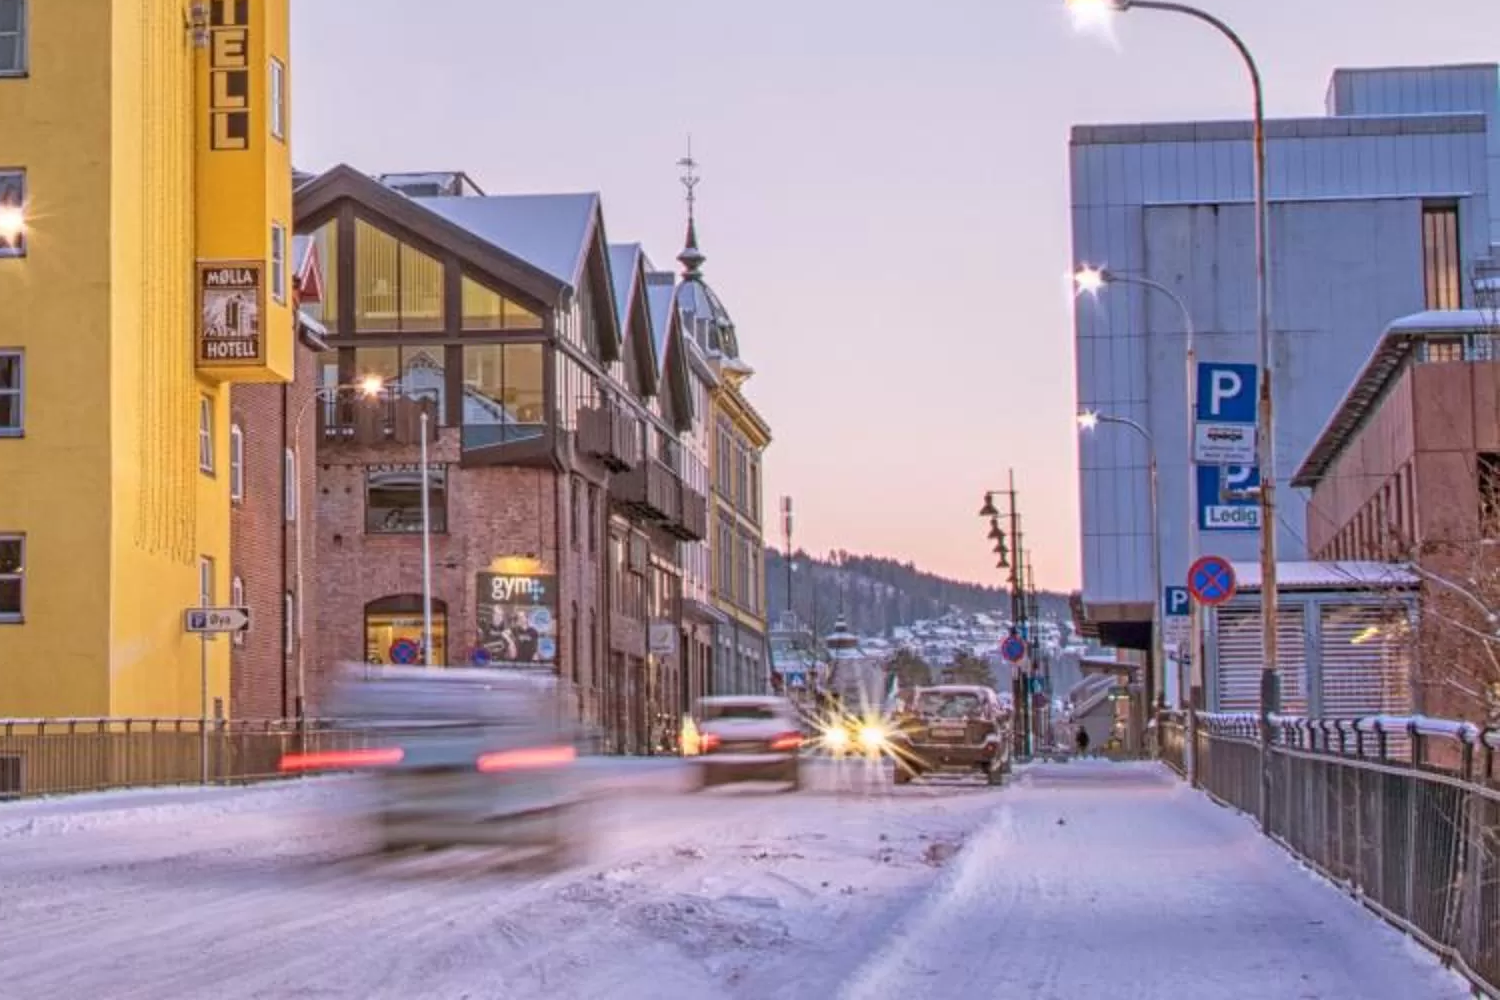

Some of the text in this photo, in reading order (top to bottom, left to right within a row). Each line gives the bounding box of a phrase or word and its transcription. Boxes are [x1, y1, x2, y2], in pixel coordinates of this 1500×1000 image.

[206, 269, 253, 285] MØLLA
[207, 341, 256, 357] HOTELL
[1210, 369, 1242, 415] P
[1210, 507, 1257, 525] Ledig
[1171, 589, 1188, 612] P
